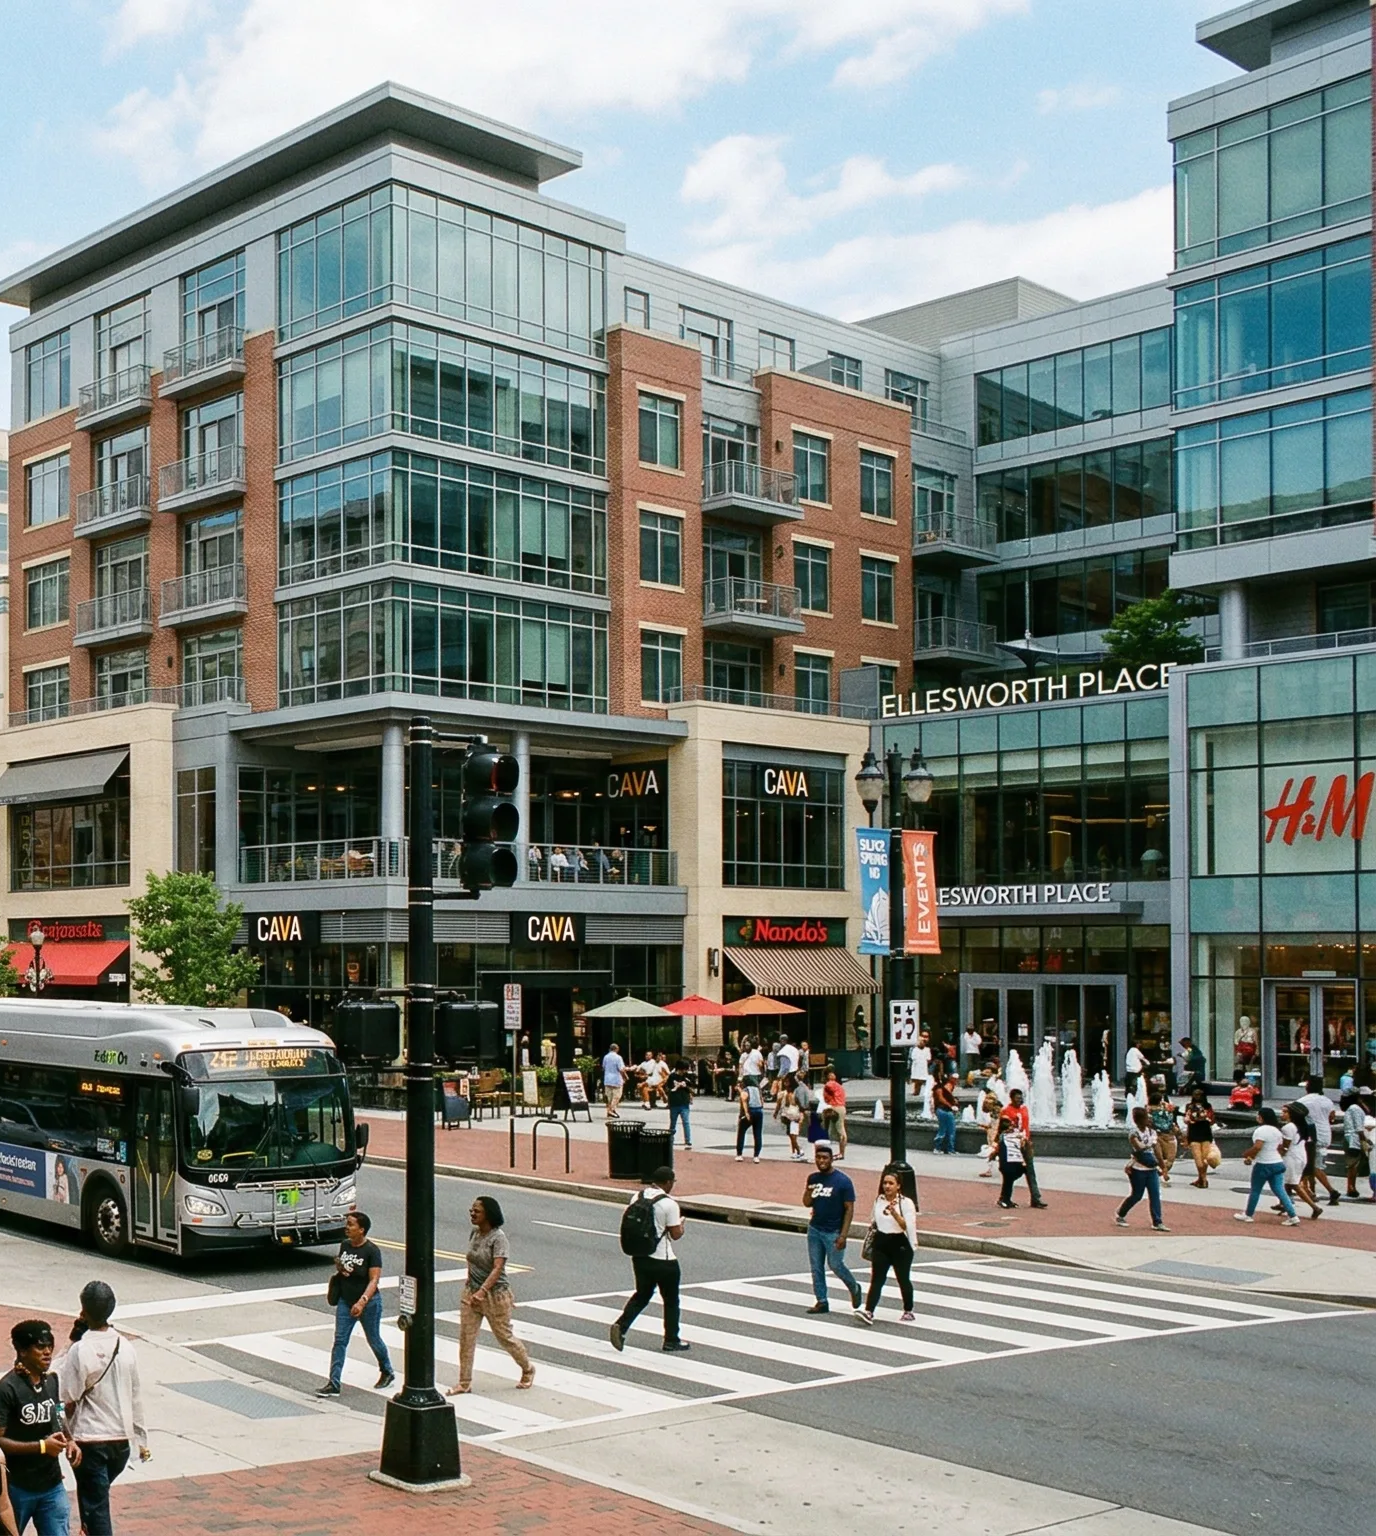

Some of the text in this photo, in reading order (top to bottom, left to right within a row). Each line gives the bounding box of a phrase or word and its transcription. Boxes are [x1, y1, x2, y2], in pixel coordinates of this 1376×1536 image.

[882, 662, 1178, 718] ELLESWORTH PLACE
[608, 769, 659, 799] CAVA
[764, 768, 809, 797] CAVA
[1264, 771, 1375, 846] H&M
[903, 882, 1111, 905] ESWORTH PLACE
[913, 842, 931, 933] EVENTS
[257, 915, 302, 942] CAVA
[528, 916, 575, 942] CAVA
[754, 918, 828, 943] Nando's
